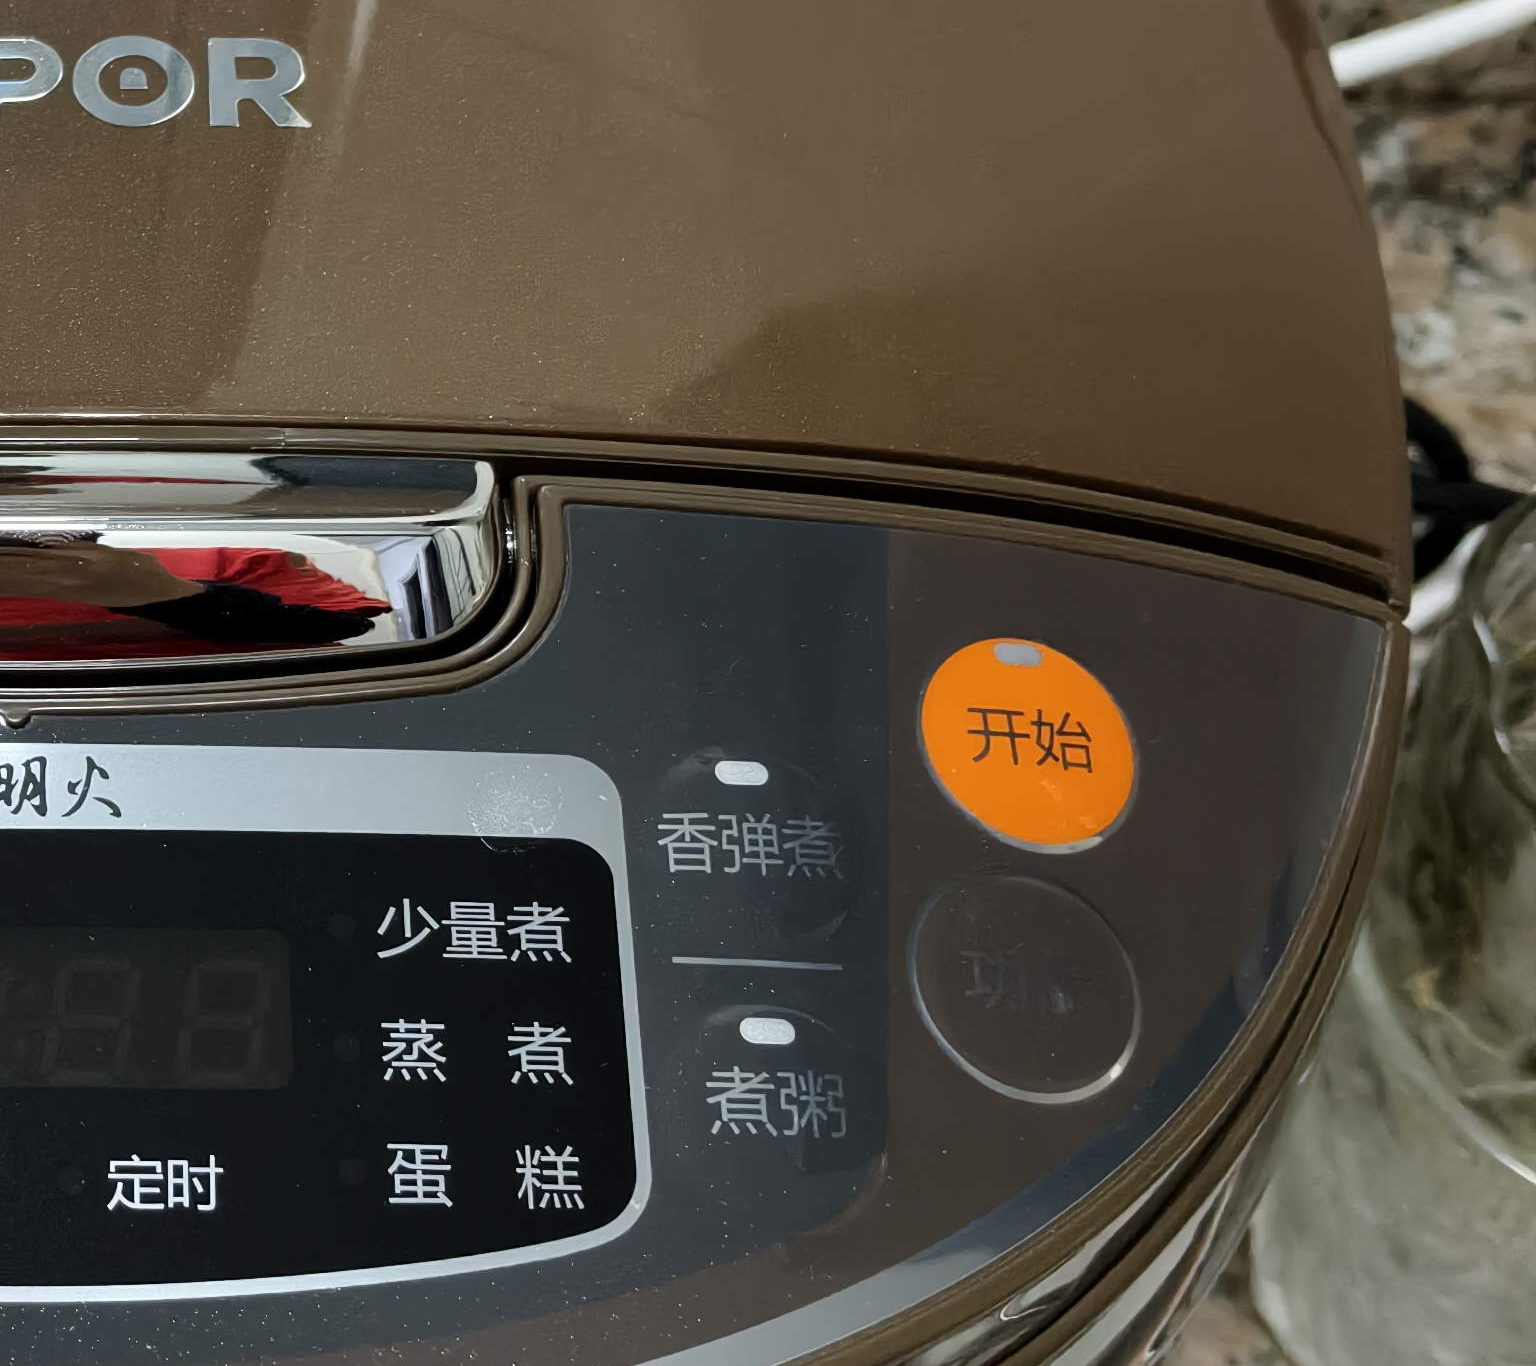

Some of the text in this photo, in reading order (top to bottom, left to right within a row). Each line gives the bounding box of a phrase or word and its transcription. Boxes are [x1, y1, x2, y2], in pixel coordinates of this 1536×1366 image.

[966, 707, 1094, 774] 开始
[657, 812, 845, 879] 香弹煮
[376, 897, 572, 963] 少量煮
[705, 1065, 847, 1140] 煮粥
[106, 1154, 225, 1212] 定时
